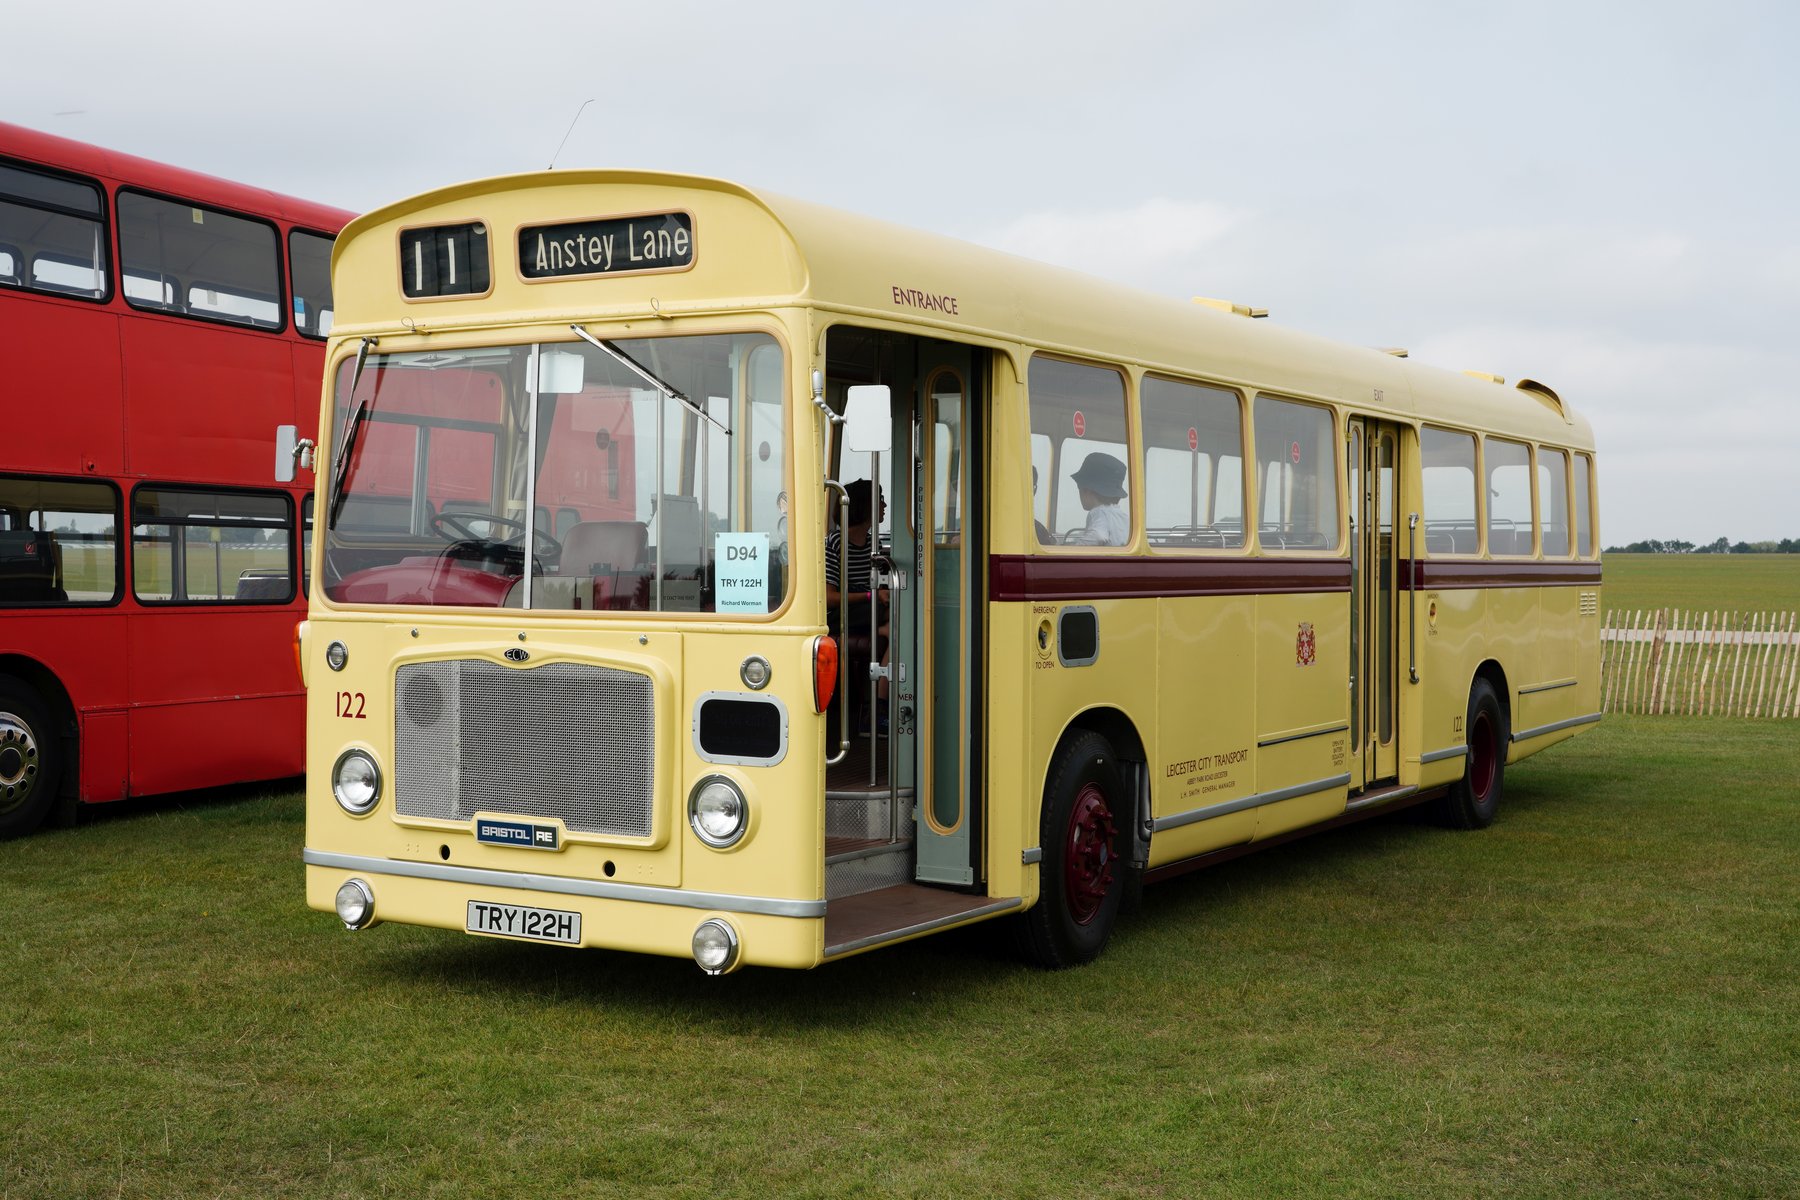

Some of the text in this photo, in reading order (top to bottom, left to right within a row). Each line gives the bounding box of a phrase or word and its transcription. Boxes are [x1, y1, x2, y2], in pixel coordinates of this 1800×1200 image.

[535, 223, 689, 271] Anstey Lane
[415, 237, 456, 291] 11
[892, 286, 959, 315] ENTRANCE
[918, 523, 924, 541] TO
[727, 545, 758, 561] D94
[720, 578, 762, 588] TRY 122H
[1033, 606, 1058, 614] EMERGENCY
[506, 648, 529, 661] ECW
[1035, 660, 1055, 670] TO OPEN
[336, 691, 367, 719] 122
[1453, 715, 1463, 733] 122
[1166, 749, 1248, 778] LEICESTER CITY TRANSPORT
[1202, 785, 1218, 794] GENERAL
[1218, 781, 1236, 791] MANAGER
[481, 825, 530, 840] BRISTOL
